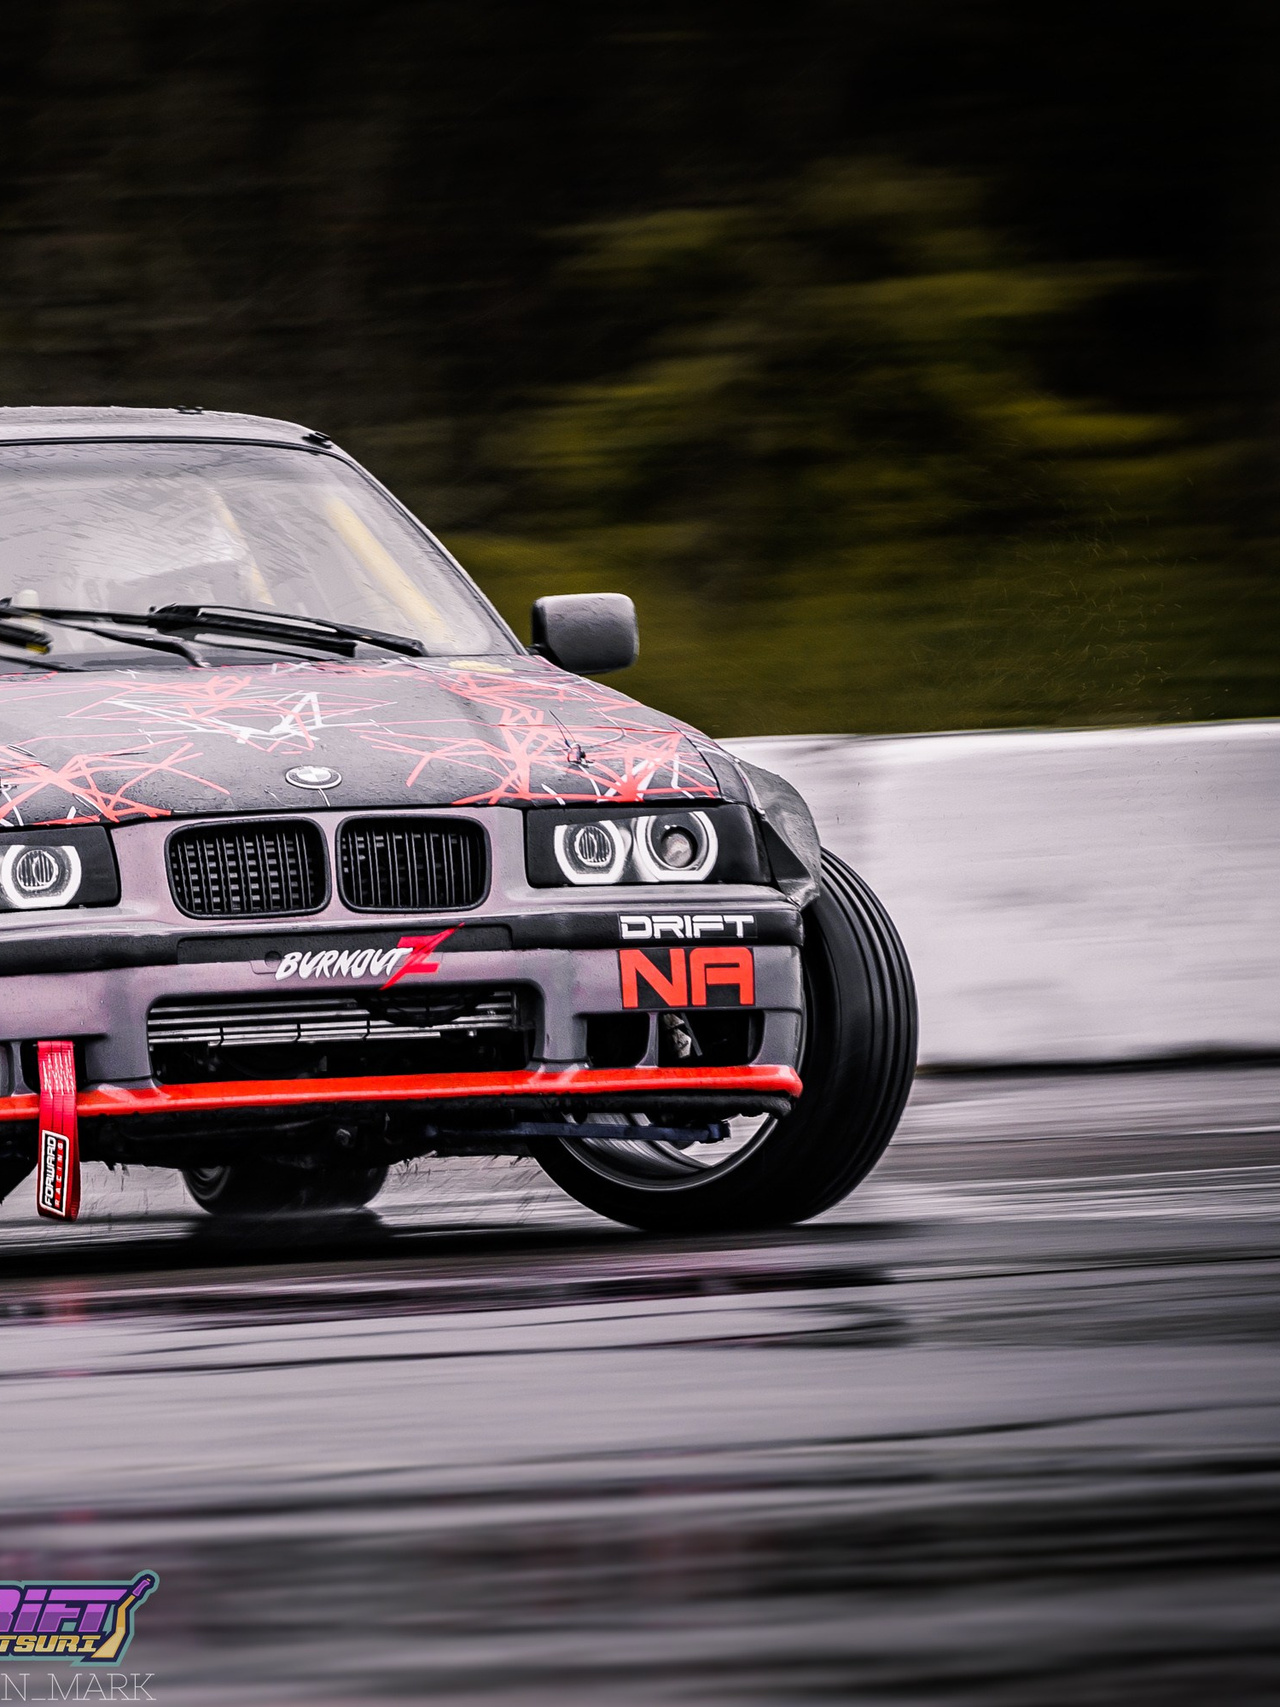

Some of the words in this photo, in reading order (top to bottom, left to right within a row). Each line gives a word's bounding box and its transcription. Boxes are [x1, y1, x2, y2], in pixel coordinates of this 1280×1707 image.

[620, 915, 755, 939] DRIFT
[619, 946, 755, 1009] NA
[44, 1136, 56, 1206] FORWARD
[55, 1142, 64, 1207] RACING
